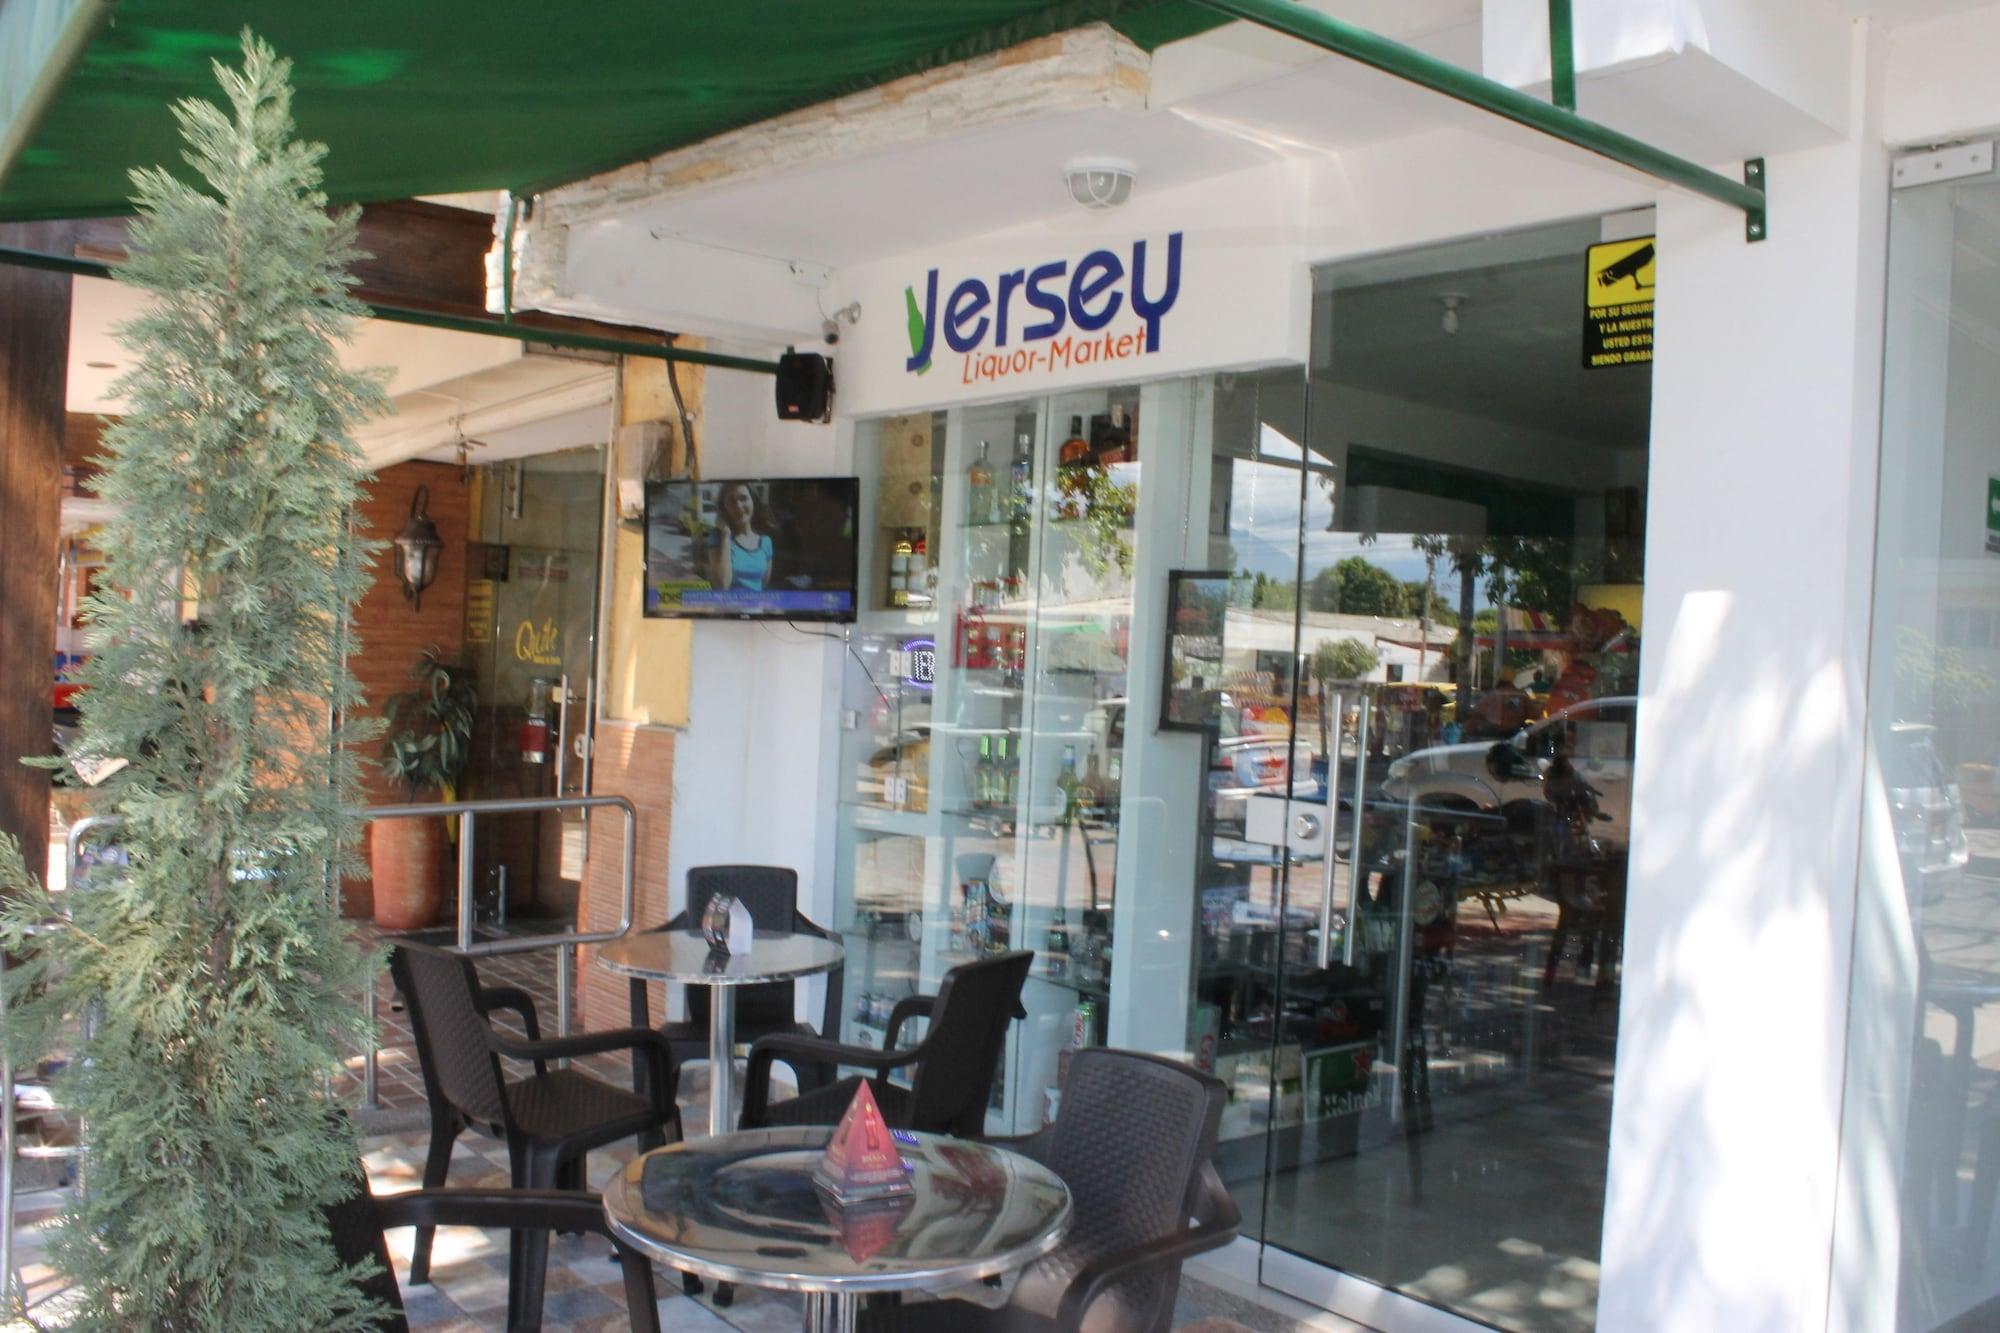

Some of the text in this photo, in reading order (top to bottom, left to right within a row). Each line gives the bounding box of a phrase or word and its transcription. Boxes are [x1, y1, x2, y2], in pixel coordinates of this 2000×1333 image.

[906, 231, 1183, 374] Jersey
[1590, 308, 1606, 319] POR
[1607, 306, 1620, 317] SU
[1599, 323, 1605, 334] Y
[1606, 321, 1617, 333] LA
[1603, 337, 1630, 349] USTED
[962, 326, 1147, 385] Liquor-Market
[1592, 354, 1621, 366] SIENDO
